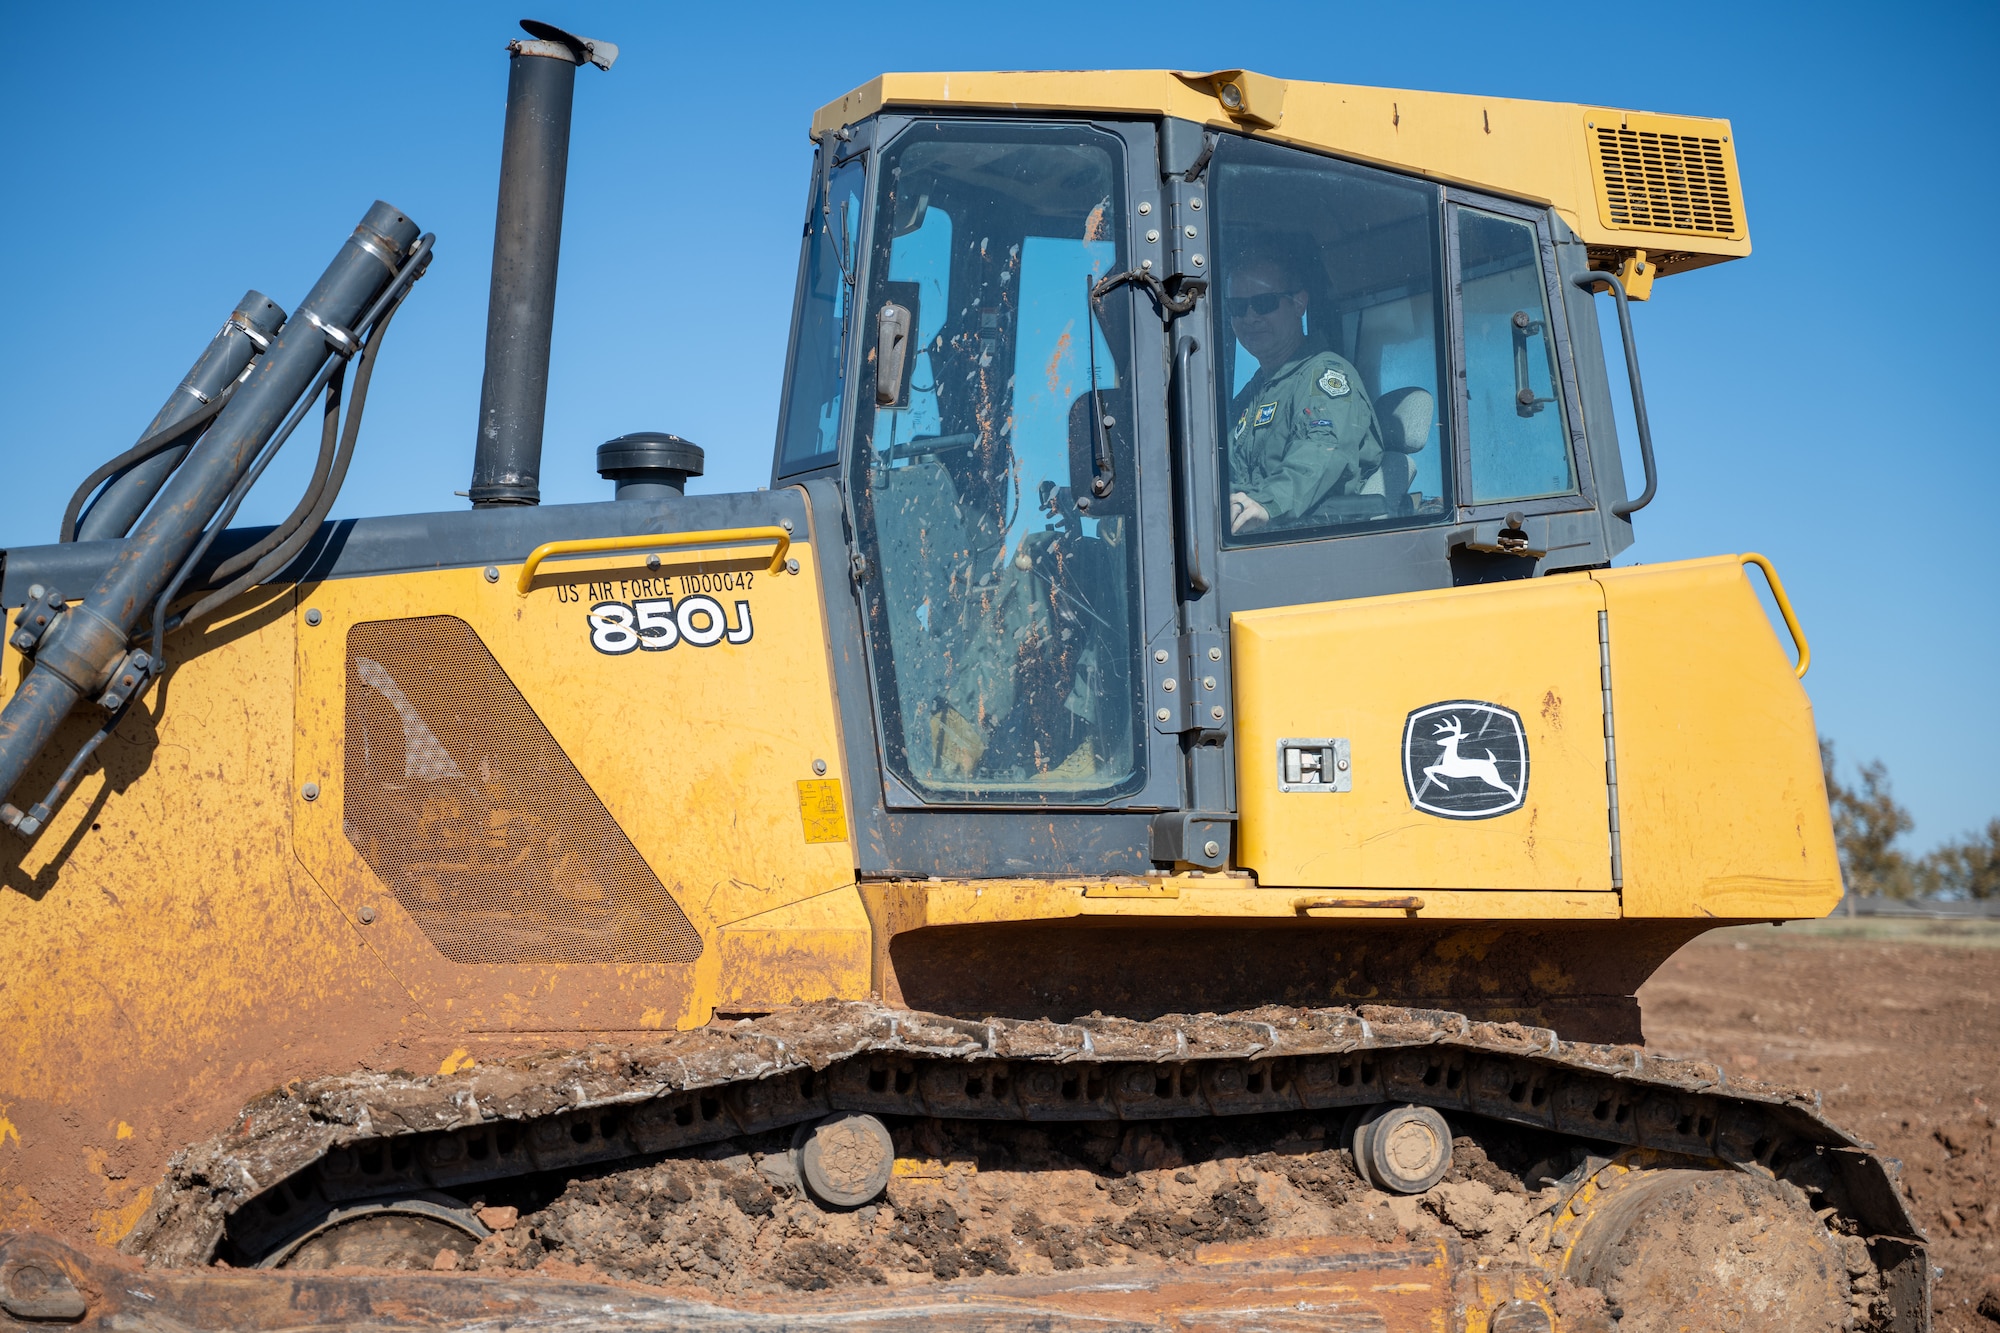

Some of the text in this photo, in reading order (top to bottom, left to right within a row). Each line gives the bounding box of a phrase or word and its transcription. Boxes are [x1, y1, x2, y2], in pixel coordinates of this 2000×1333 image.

[557, 583, 579, 603] US
[589, 582, 614, 601] AIR
[620, 577, 673, 598] FORCE
[587, 594, 754, 656] 850J
